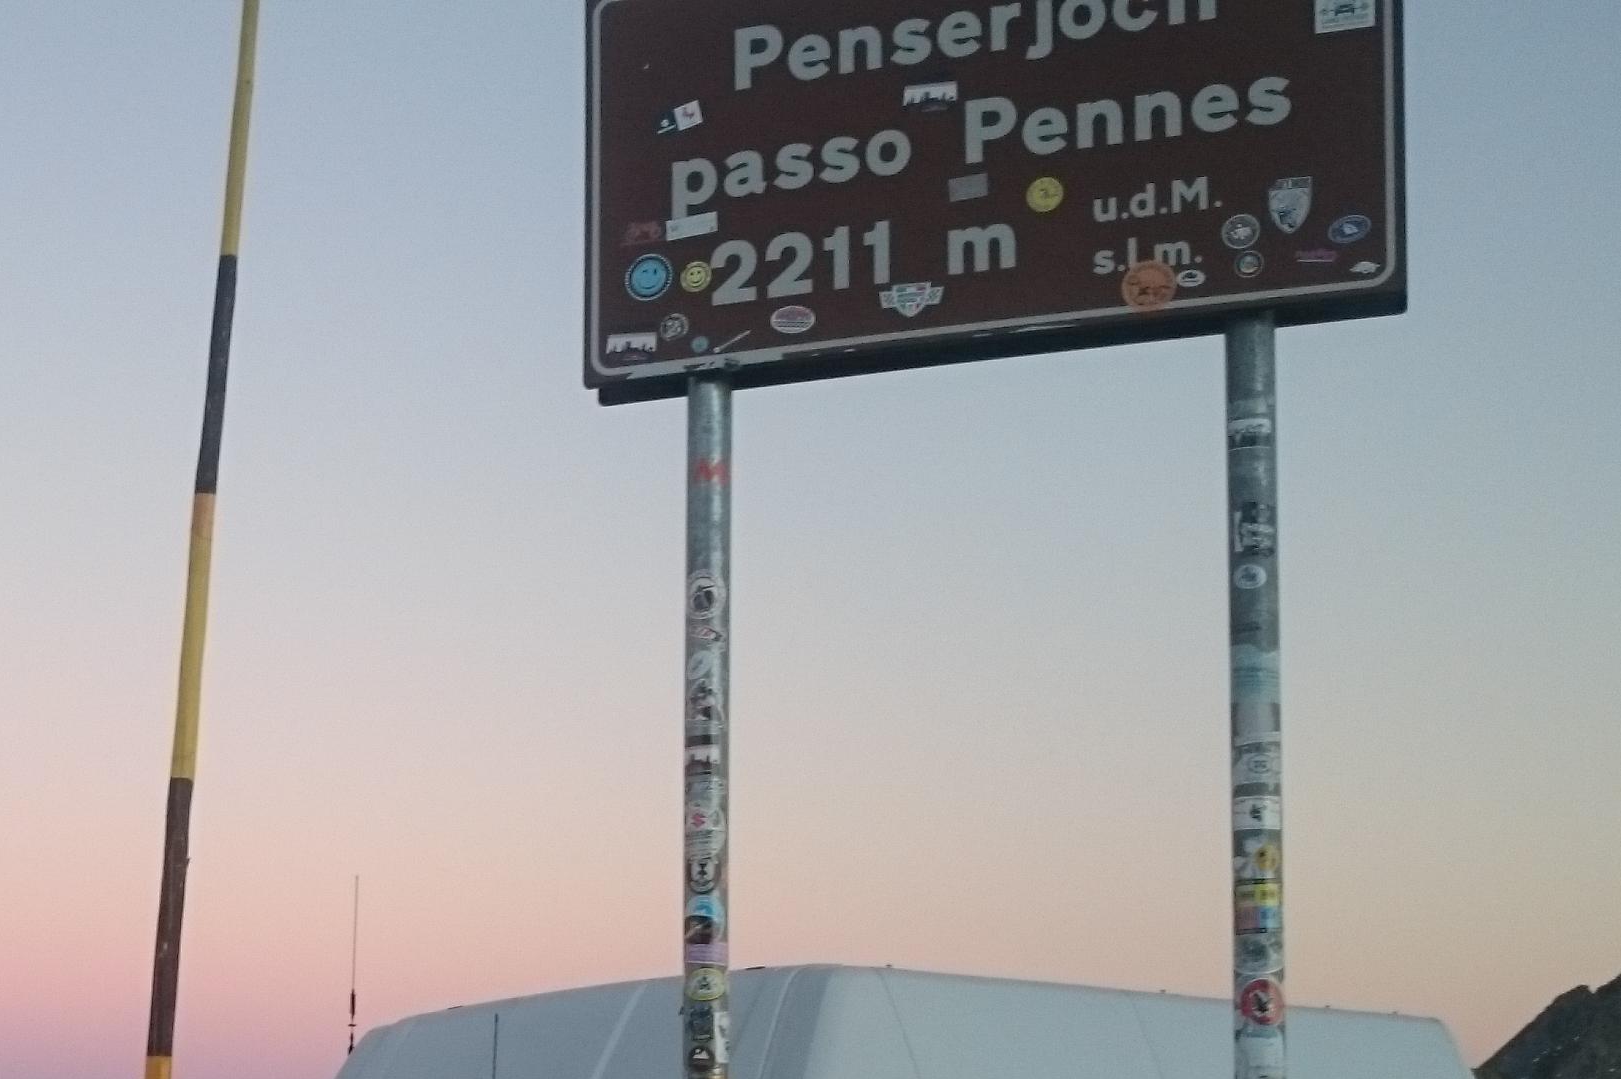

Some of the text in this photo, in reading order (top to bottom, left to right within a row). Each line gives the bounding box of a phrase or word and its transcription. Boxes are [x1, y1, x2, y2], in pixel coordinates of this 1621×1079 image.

[670, 75, 1293, 220] passo Pennes
[1092, 176, 1223, 222] u.d.M.
[711, 220, 891, 306] 2211
[947, 222, 1017, 276] m
[1092, 236, 1203, 275] s.lm.
